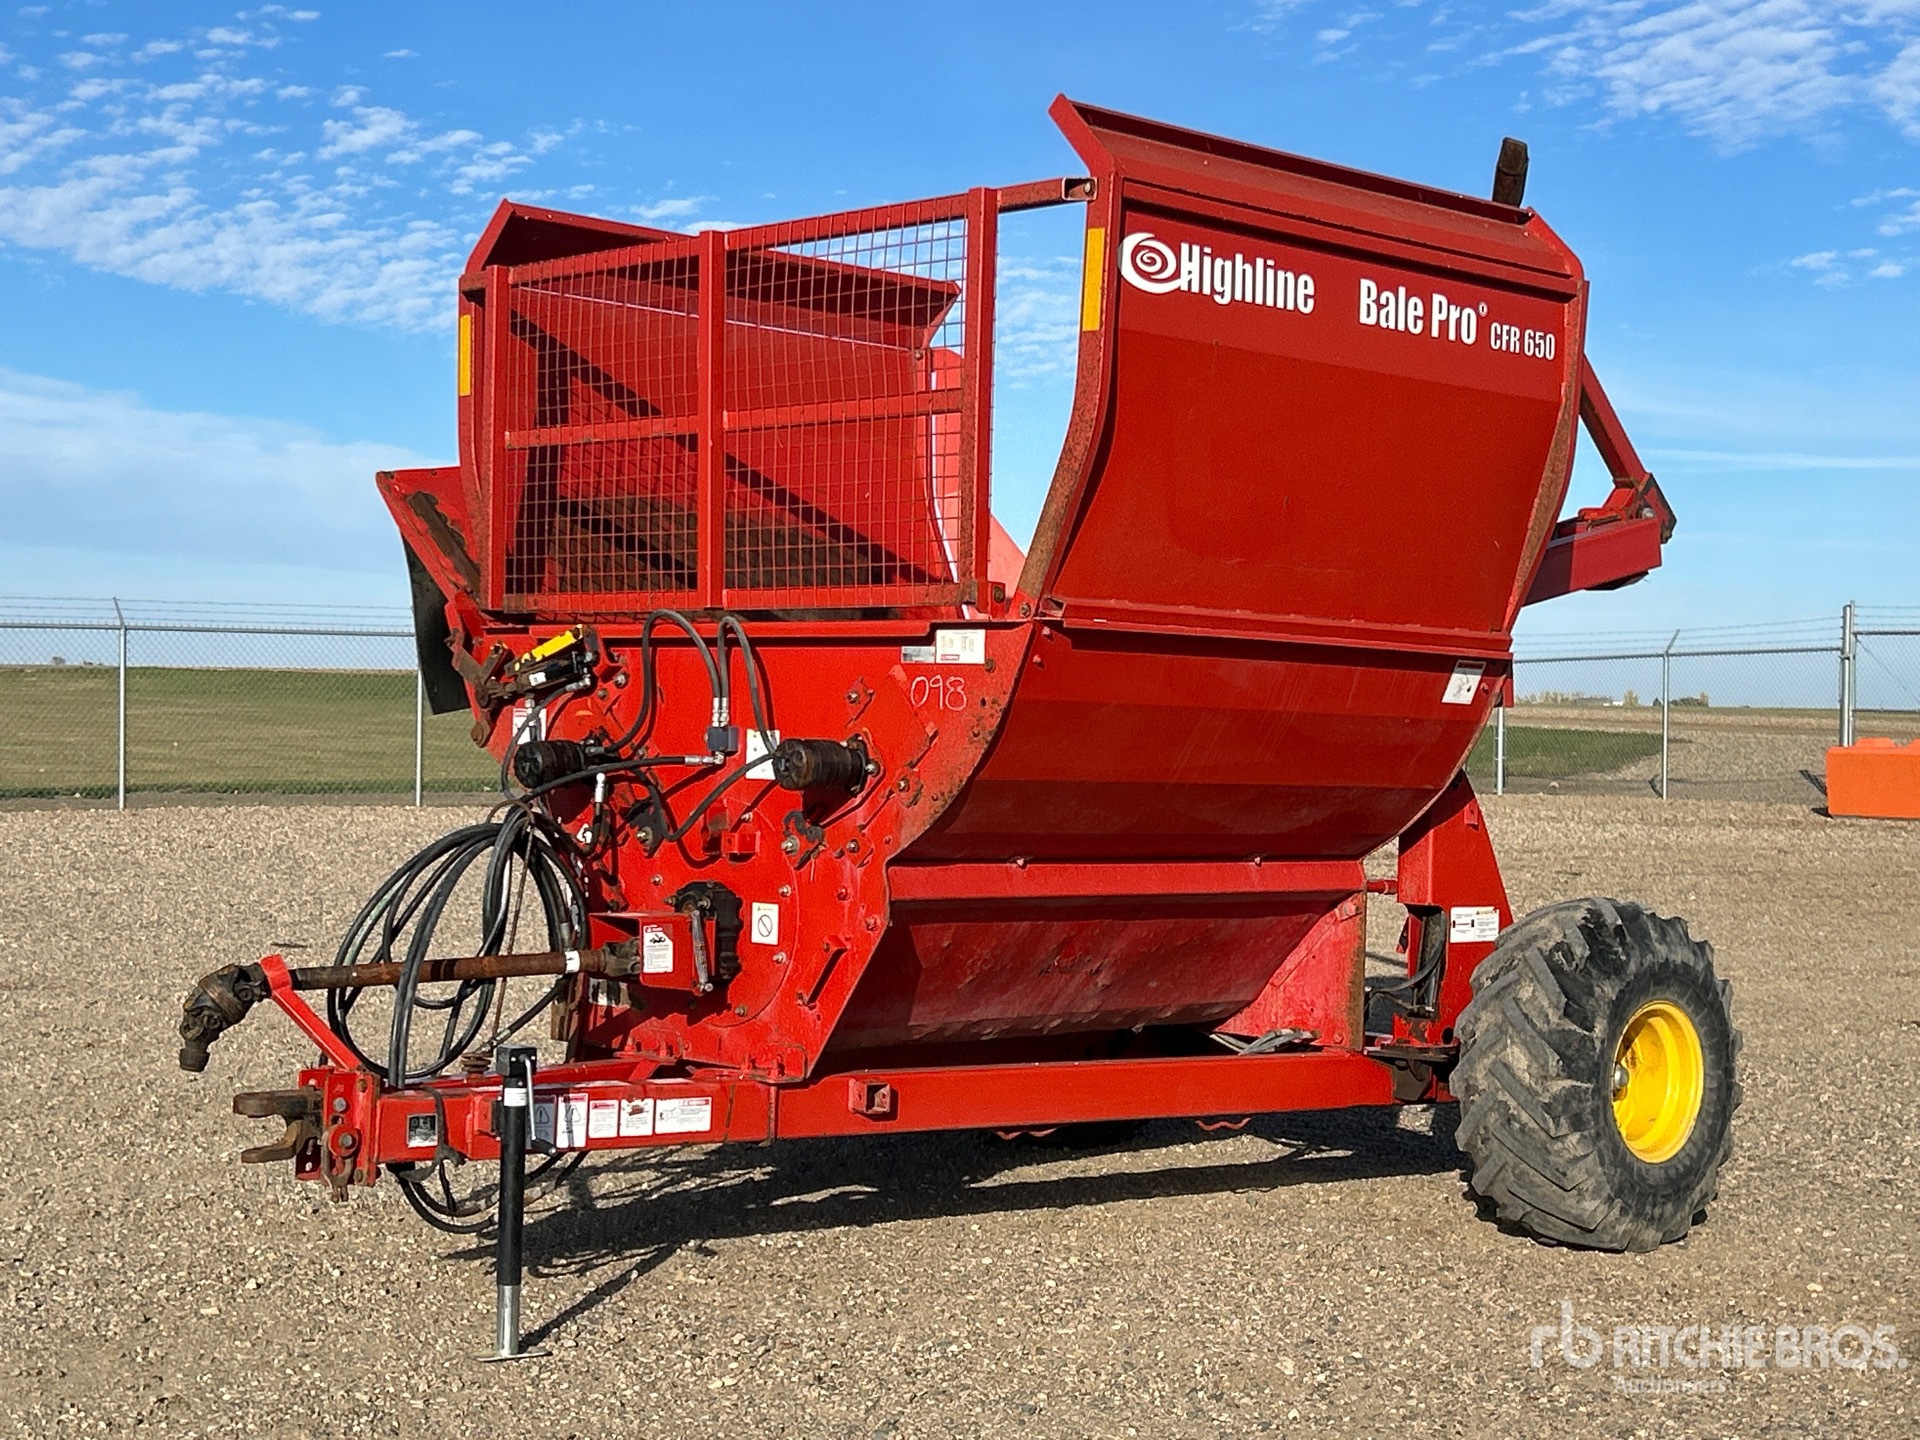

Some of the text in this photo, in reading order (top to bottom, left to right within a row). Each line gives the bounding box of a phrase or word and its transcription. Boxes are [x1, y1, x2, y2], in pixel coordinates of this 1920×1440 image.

[1178, 240, 1316, 316] Highline
[1359, 278, 1425, 336] Bale
[1490, 321, 1521, 355] CFR
[1523, 328, 1556, 361] 650
[910, 674, 967, 711] 098
